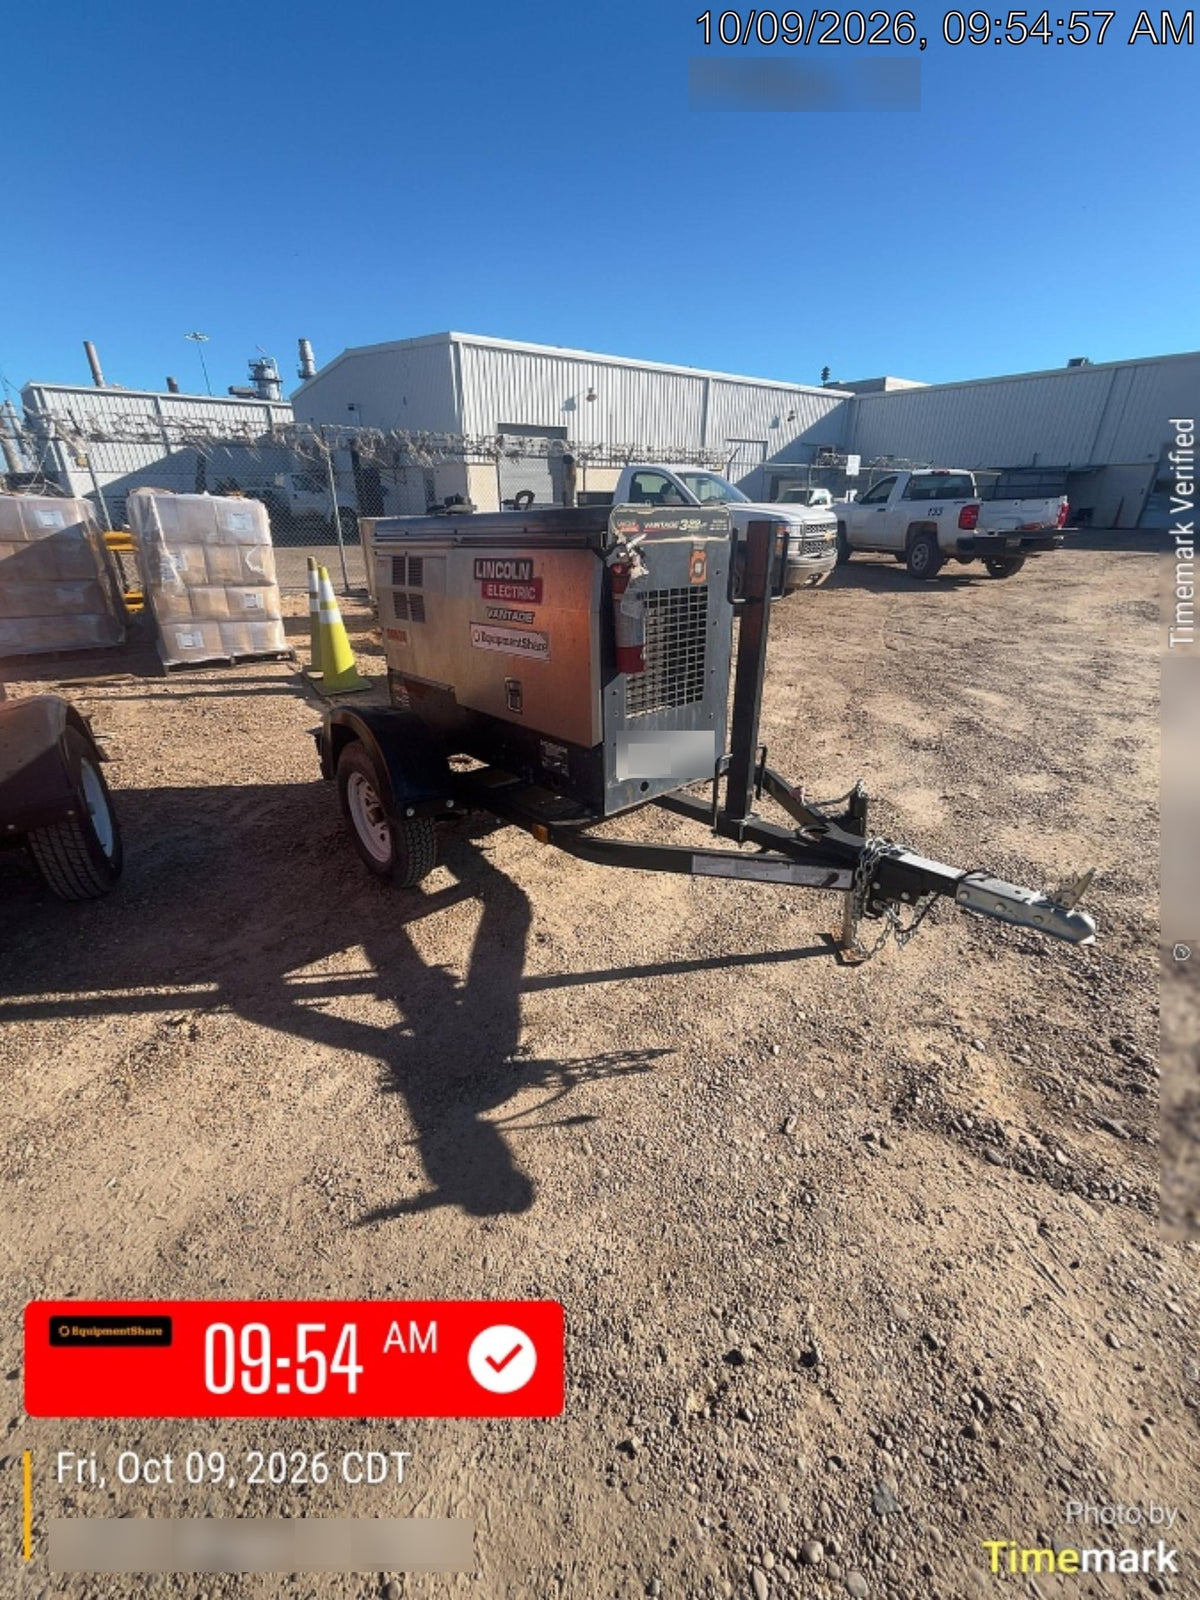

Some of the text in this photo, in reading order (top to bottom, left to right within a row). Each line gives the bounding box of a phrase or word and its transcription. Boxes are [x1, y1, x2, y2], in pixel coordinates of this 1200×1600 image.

[475, 560, 531, 580] LINCOLN
[487, 584, 536, 600] ELECTRIC
[486, 606, 535, 624] VANTAGE
